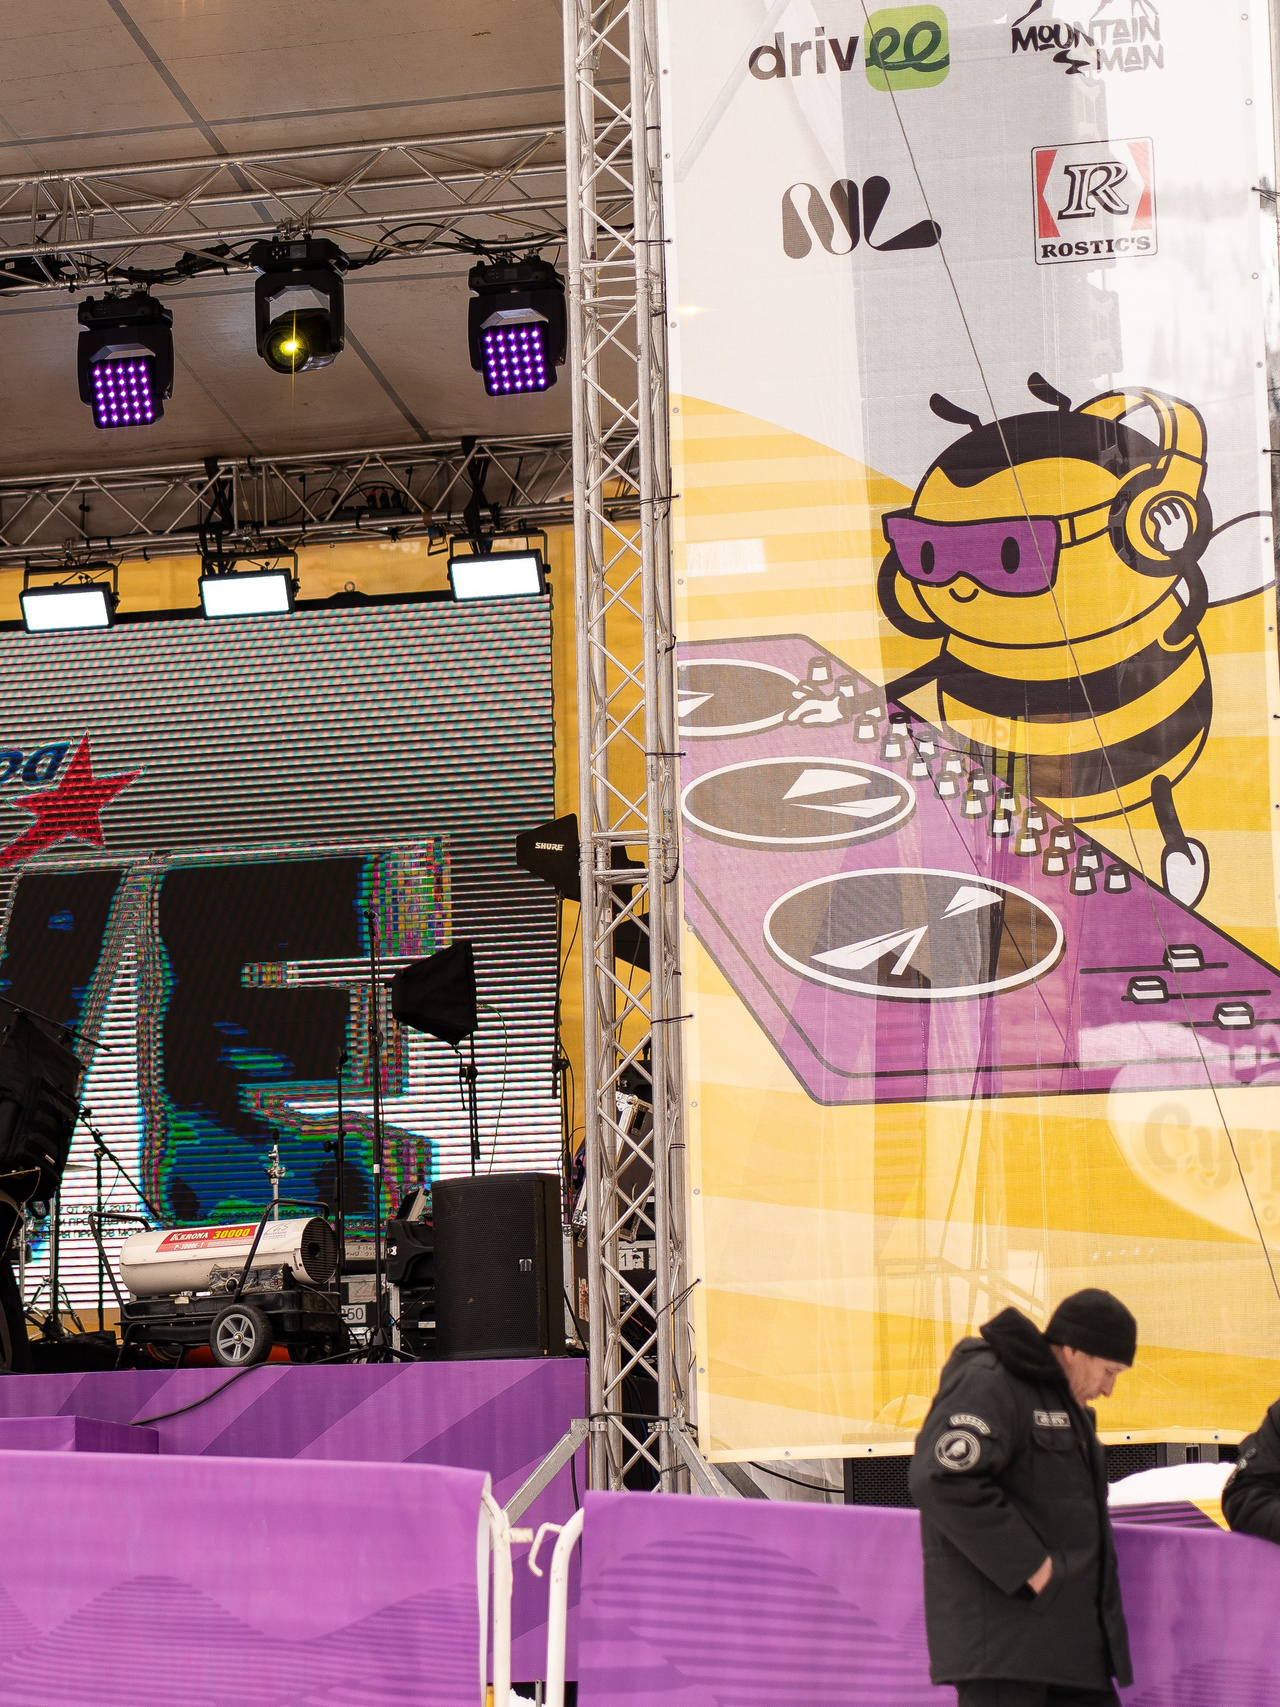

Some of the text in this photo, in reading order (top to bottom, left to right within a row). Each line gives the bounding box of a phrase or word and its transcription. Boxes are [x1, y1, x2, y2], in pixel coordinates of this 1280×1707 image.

[748, 19, 950, 81] drivee
[1096, 43, 1164, 74] MAN
[1041, 235, 1151, 259] ROSTIC'S
[534, 842, 565, 851] SHURE
[170, 1232, 208, 1242] KERONA
[212, 1228, 251, 1239] 30000
